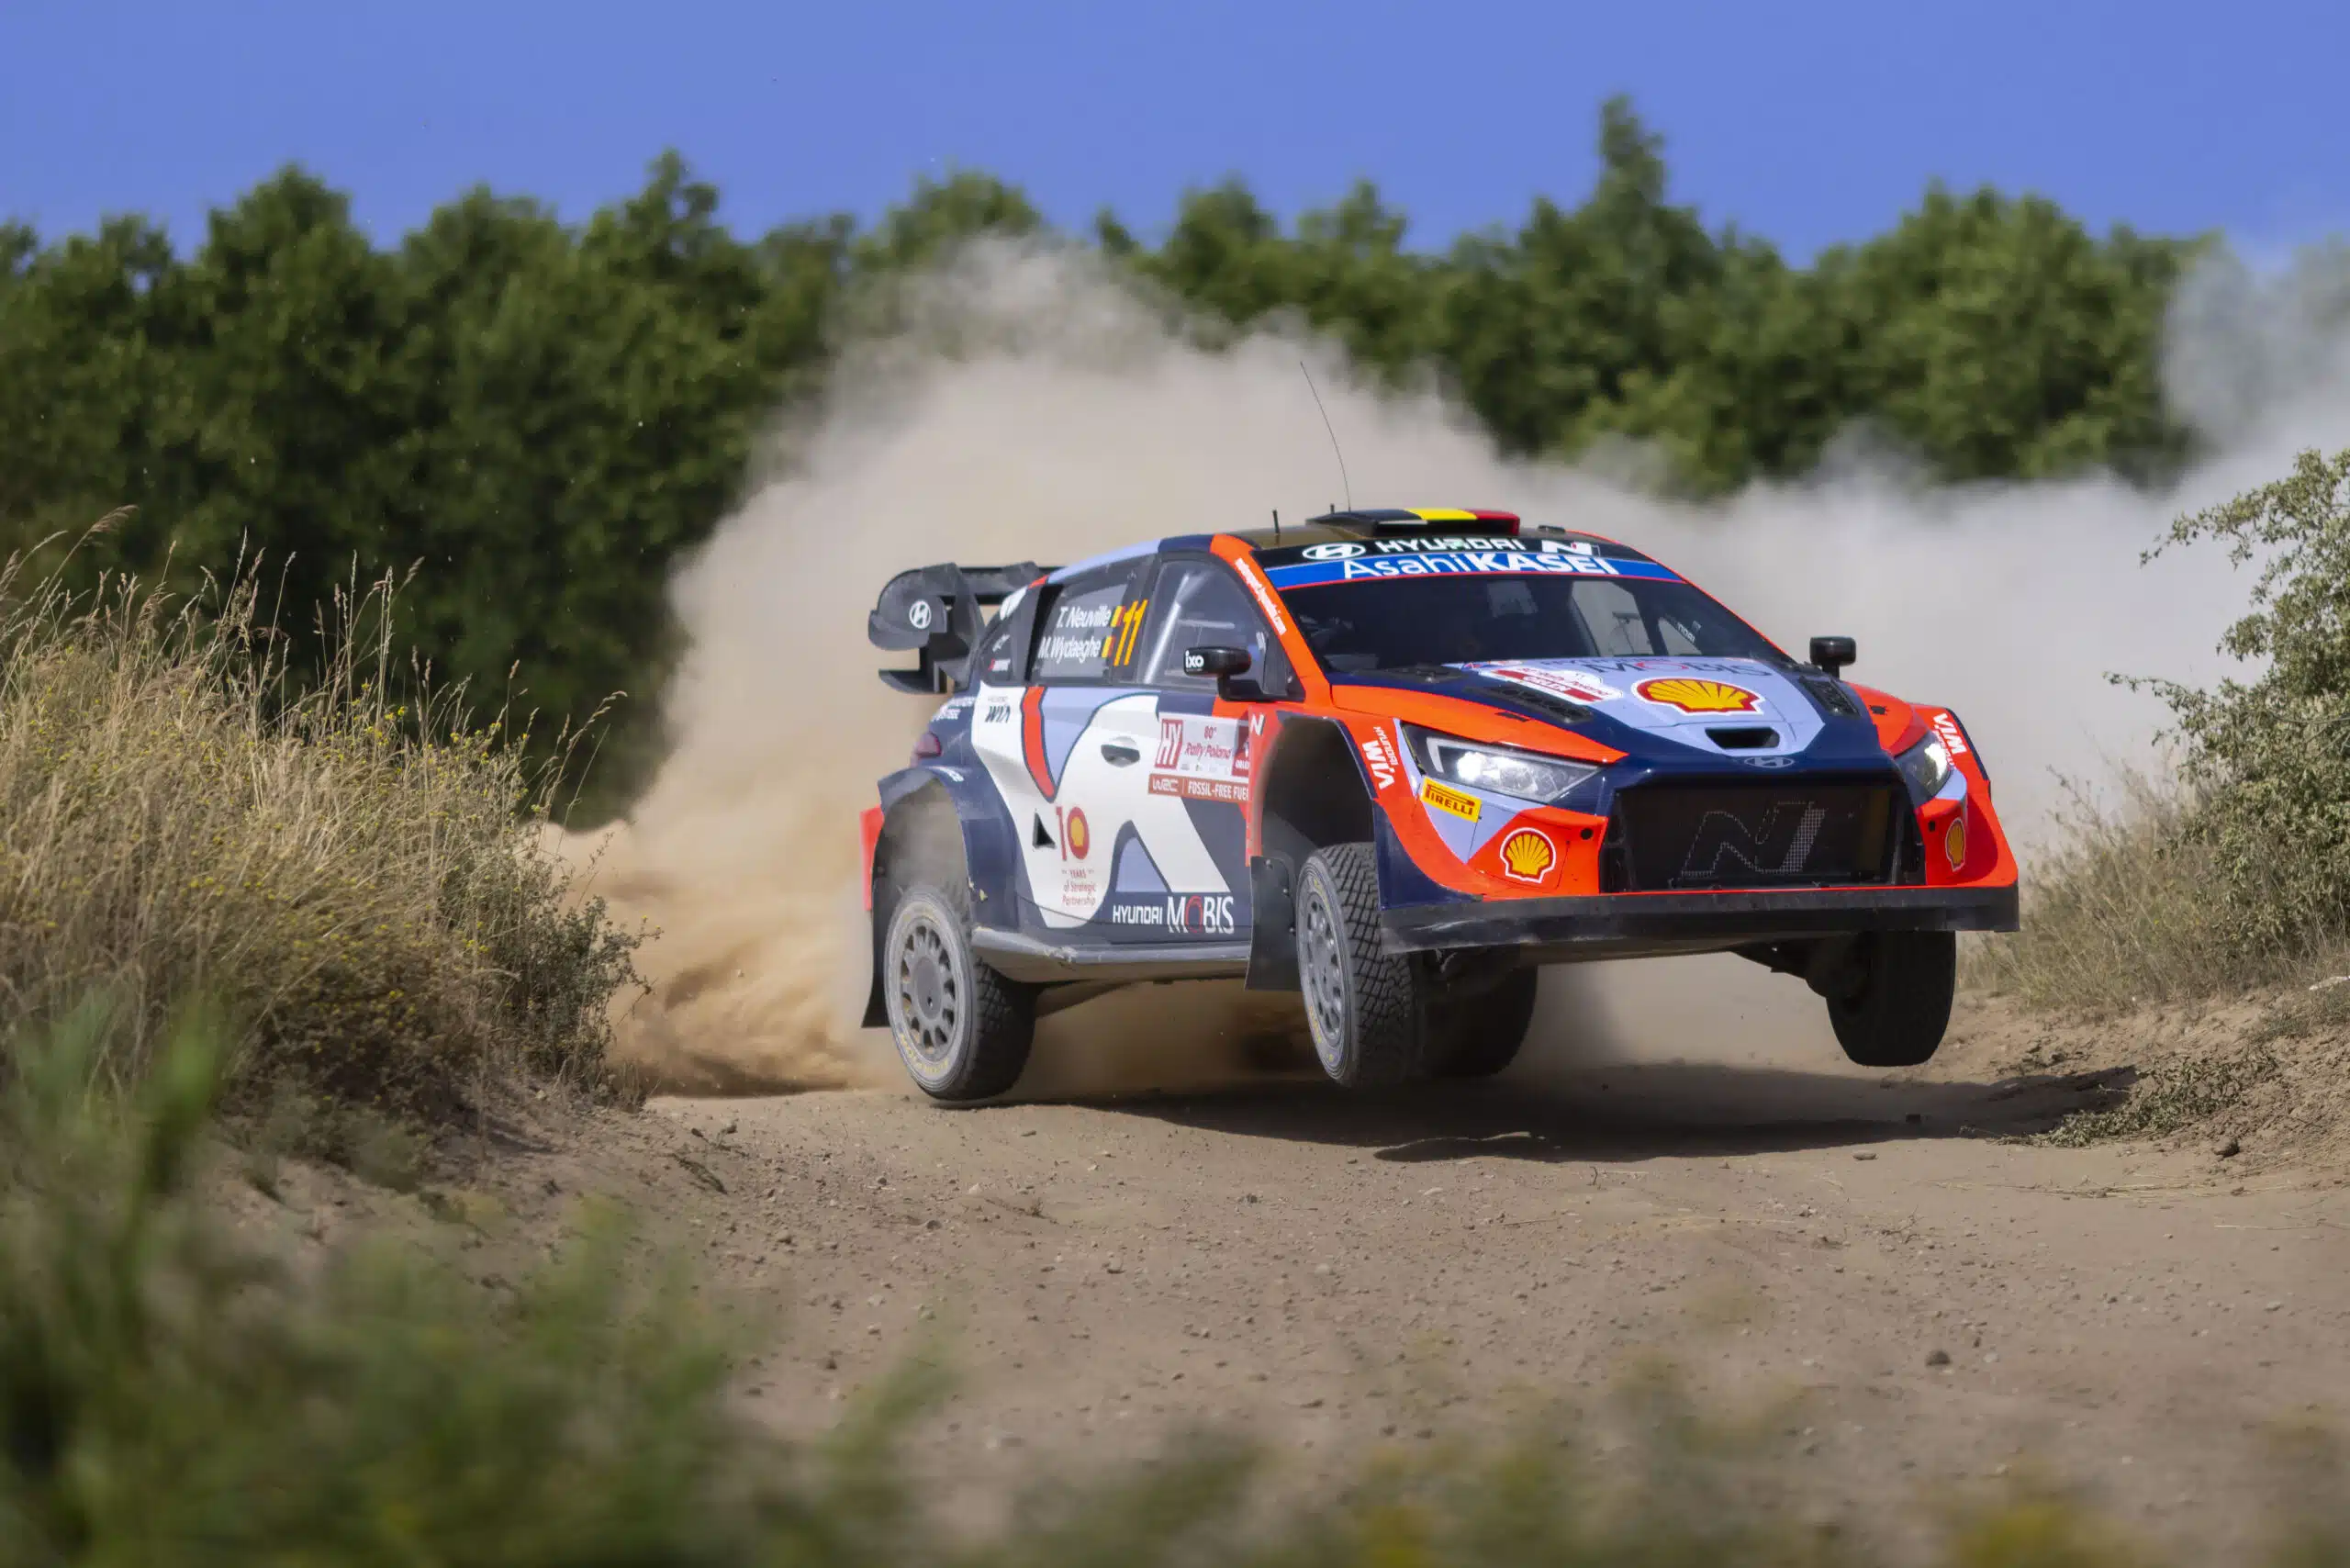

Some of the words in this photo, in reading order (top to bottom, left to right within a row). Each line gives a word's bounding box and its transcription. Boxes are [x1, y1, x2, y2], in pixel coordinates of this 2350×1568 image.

[1374, 537, 1527, 554] HYUNDAI
[1066, 604, 1112, 628] Neuville
[1113, 599, 1148, 666] 11
[1185, 650, 1204, 668] ixo
[1248, 713, 1266, 736] N
[1157, 722, 1182, 767] HY
[1426, 783, 1475, 816] PIRELLI
[1113, 905, 1163, 924] HYUNDAI
[1167, 895, 1235, 935] MOBIS
